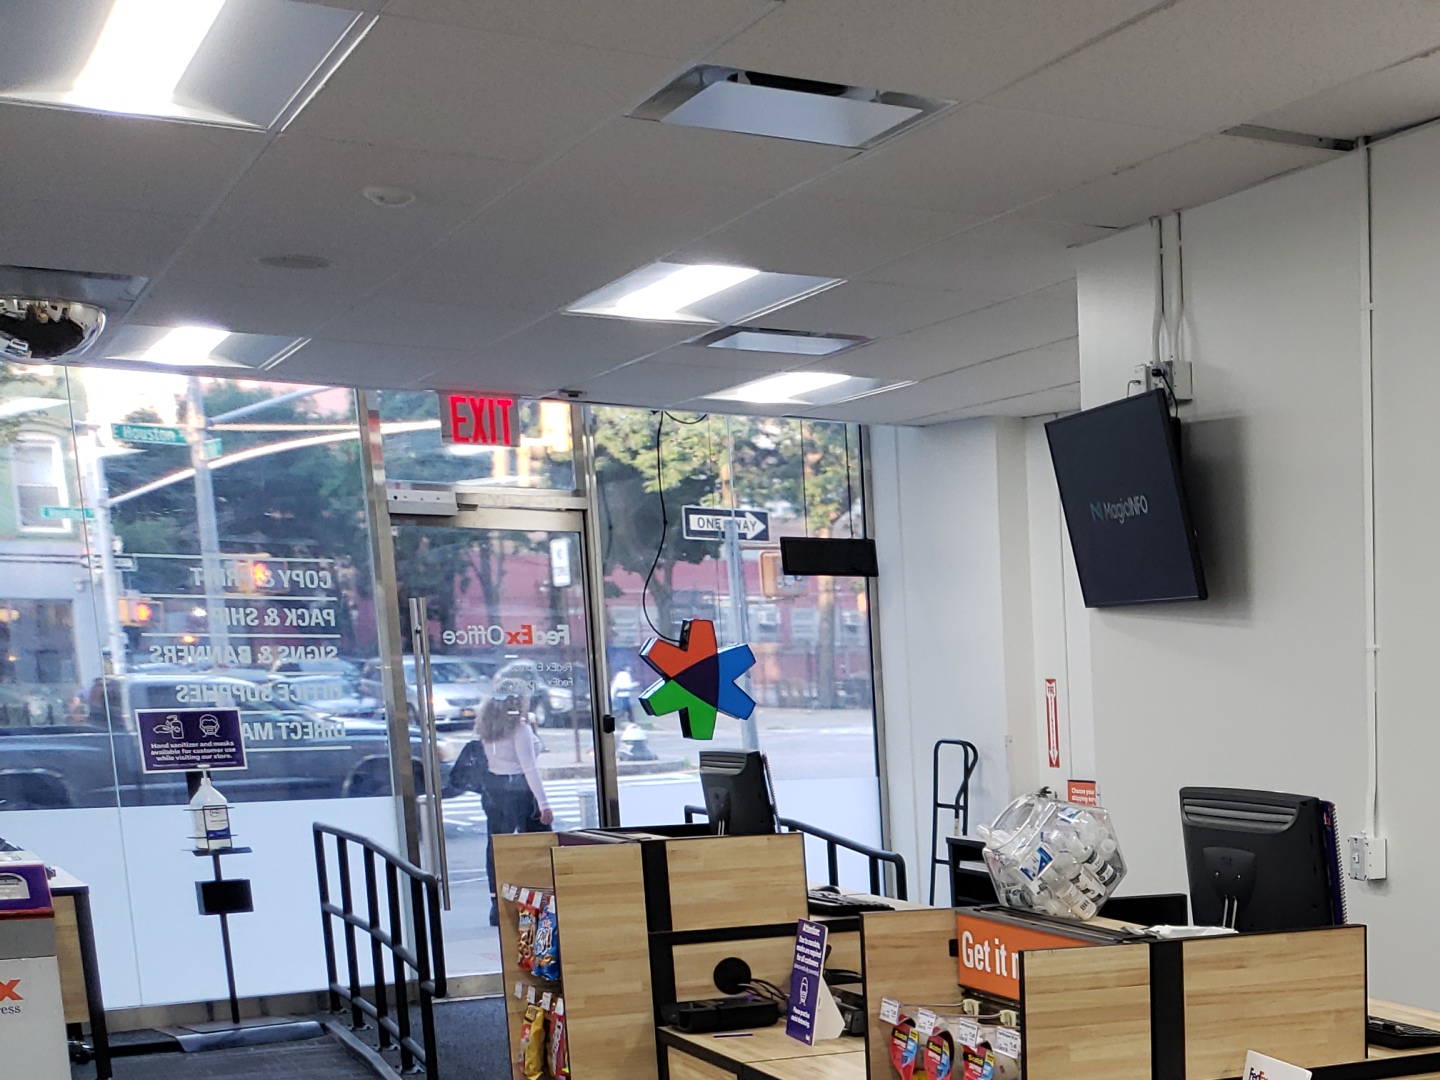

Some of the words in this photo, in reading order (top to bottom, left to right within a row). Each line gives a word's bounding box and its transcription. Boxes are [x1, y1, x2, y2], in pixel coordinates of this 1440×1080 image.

[450, 395, 513, 446] EXIT
[697, 517, 721, 529] ONE
[961, 930, 991, 973] Get
[995, 937, 1008, 977] it
